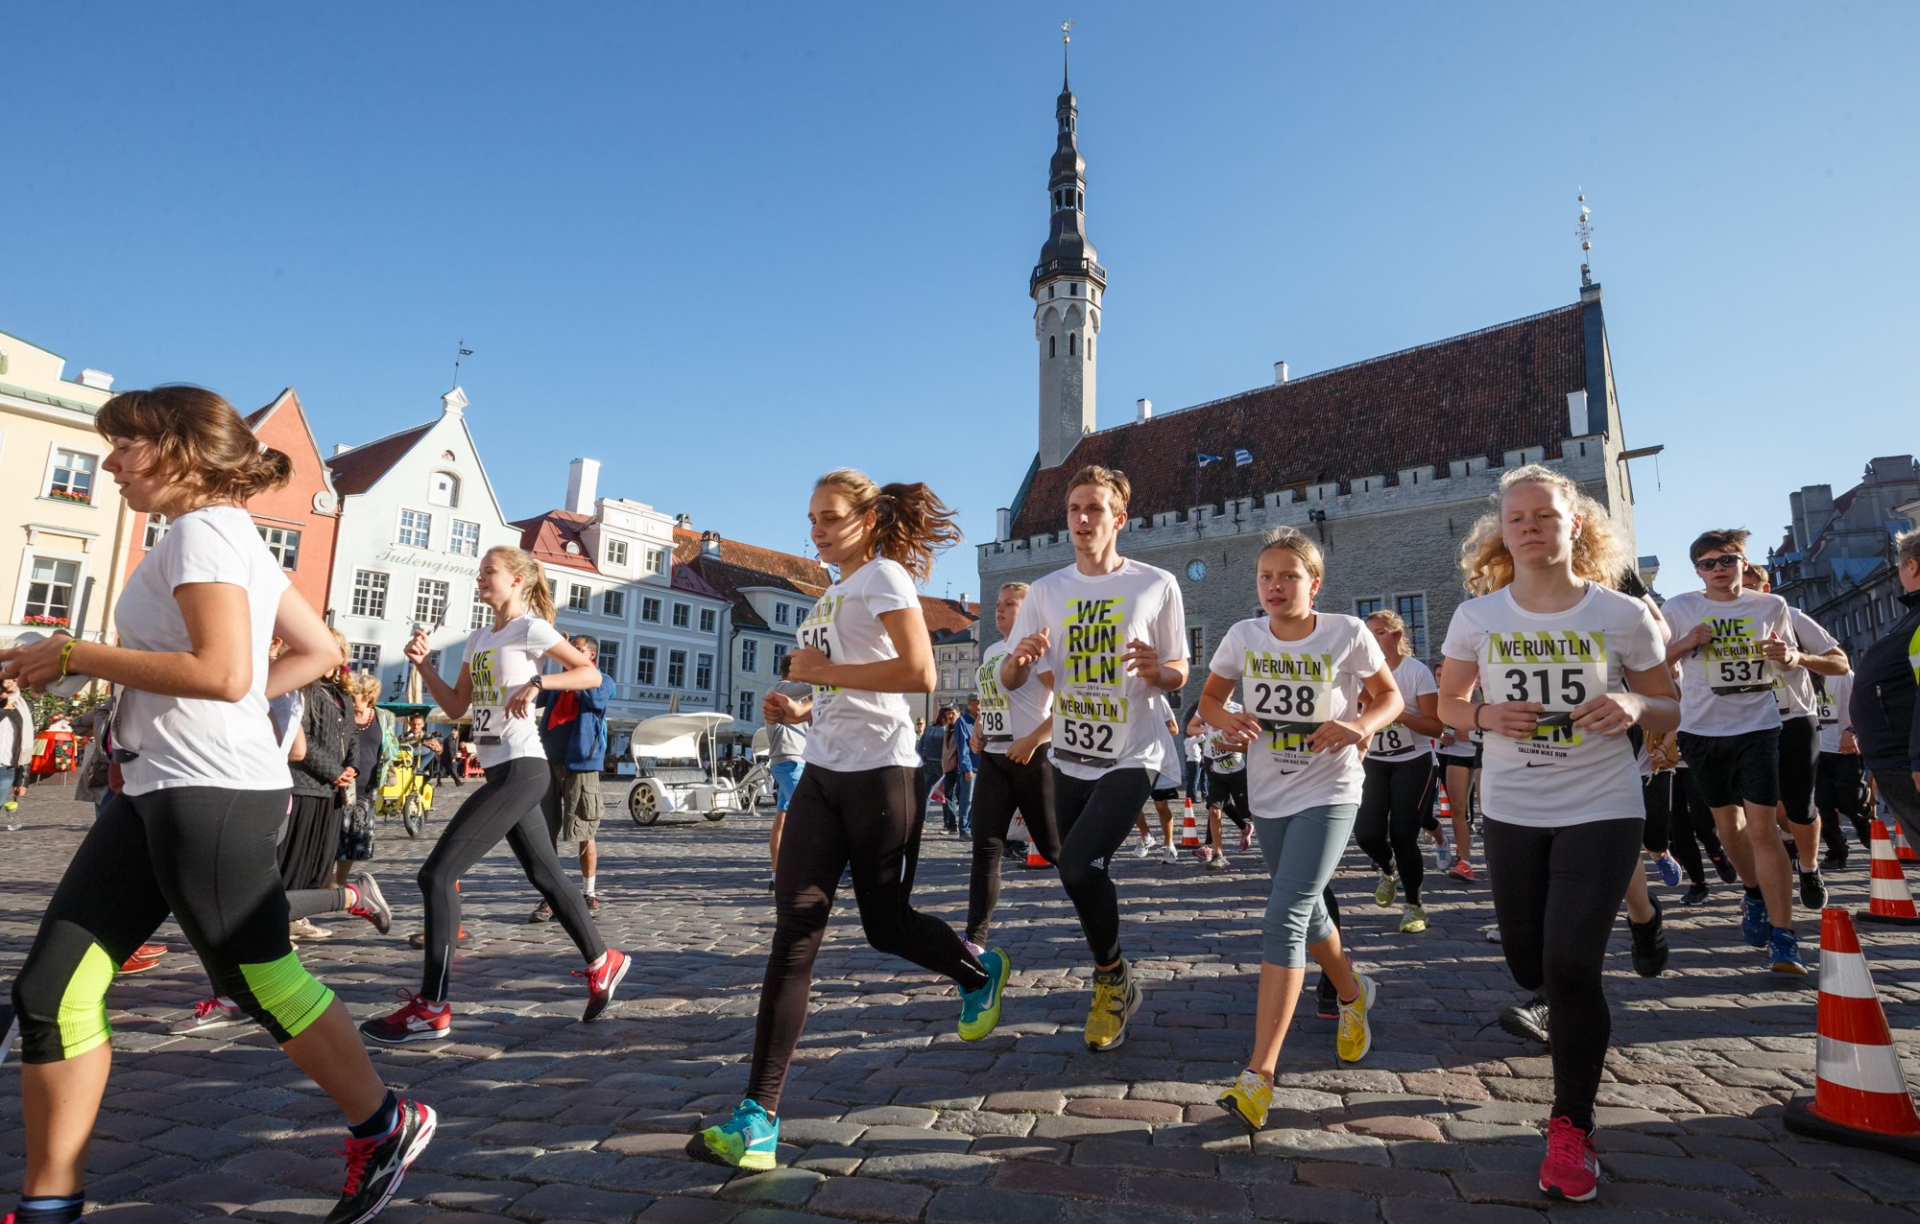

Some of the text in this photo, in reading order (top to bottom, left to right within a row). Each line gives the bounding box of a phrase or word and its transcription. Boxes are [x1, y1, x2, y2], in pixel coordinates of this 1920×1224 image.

[1077, 599, 1114, 624] WE
[1712, 618, 1746, 636] WE
[1069, 625, 1116, 653] RUN
[1500, 639, 1591, 656] WE RUN TLN
[473, 650, 491, 671] WE
[1730, 646, 1748, 656] RUN
[1751, 645, 1763, 654] TL
[1070, 655, 1115, 684] TLN
[1252, 658, 1321, 676] WE RUN TLN
[1720, 660, 1765, 683] 537
[639, 691, 708, 702] KAERJAAN
[1505, 668, 1586, 705] 315
[1060, 697, 1118, 718] WE RUN TLN
[1254, 682, 1315, 717] 238
[981, 712, 1004, 731] 798
[1064, 719, 1114, 754] 532
[1518, 746, 1540, 755] TALLINN
